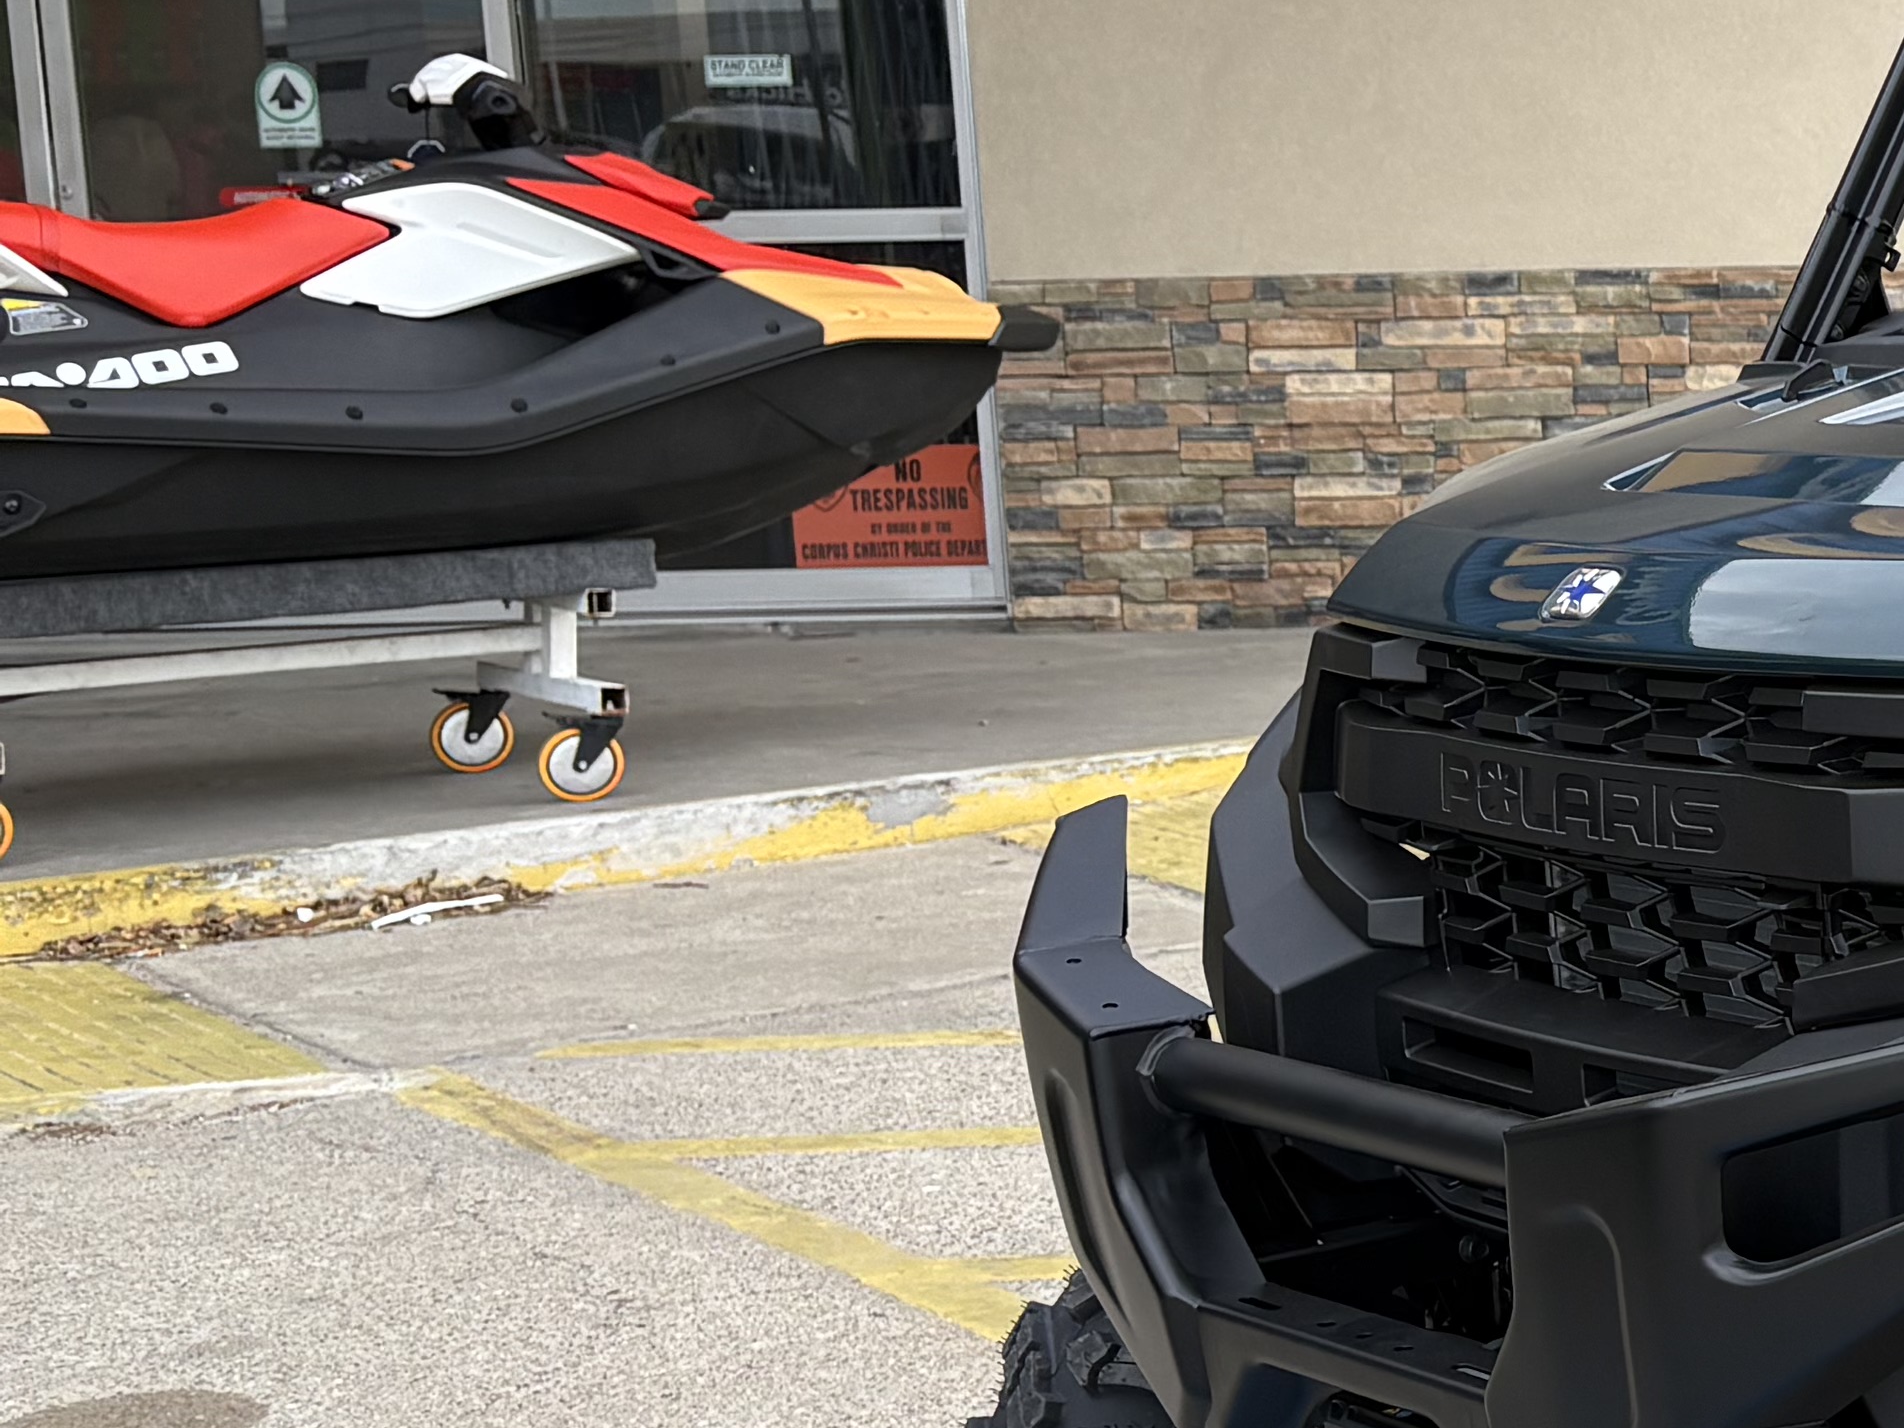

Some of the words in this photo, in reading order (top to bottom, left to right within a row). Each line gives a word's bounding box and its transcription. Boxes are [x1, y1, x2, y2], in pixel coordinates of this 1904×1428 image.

[894, 459, 922, 483] NO
[850, 486, 969, 512] TRESPASSING
[802, 543, 849, 560] CORPUS
[854, 541, 899, 559] CHRISTI
[904, 540, 942, 558] POLICE
[1438, 750, 1726, 858] POLARIS
